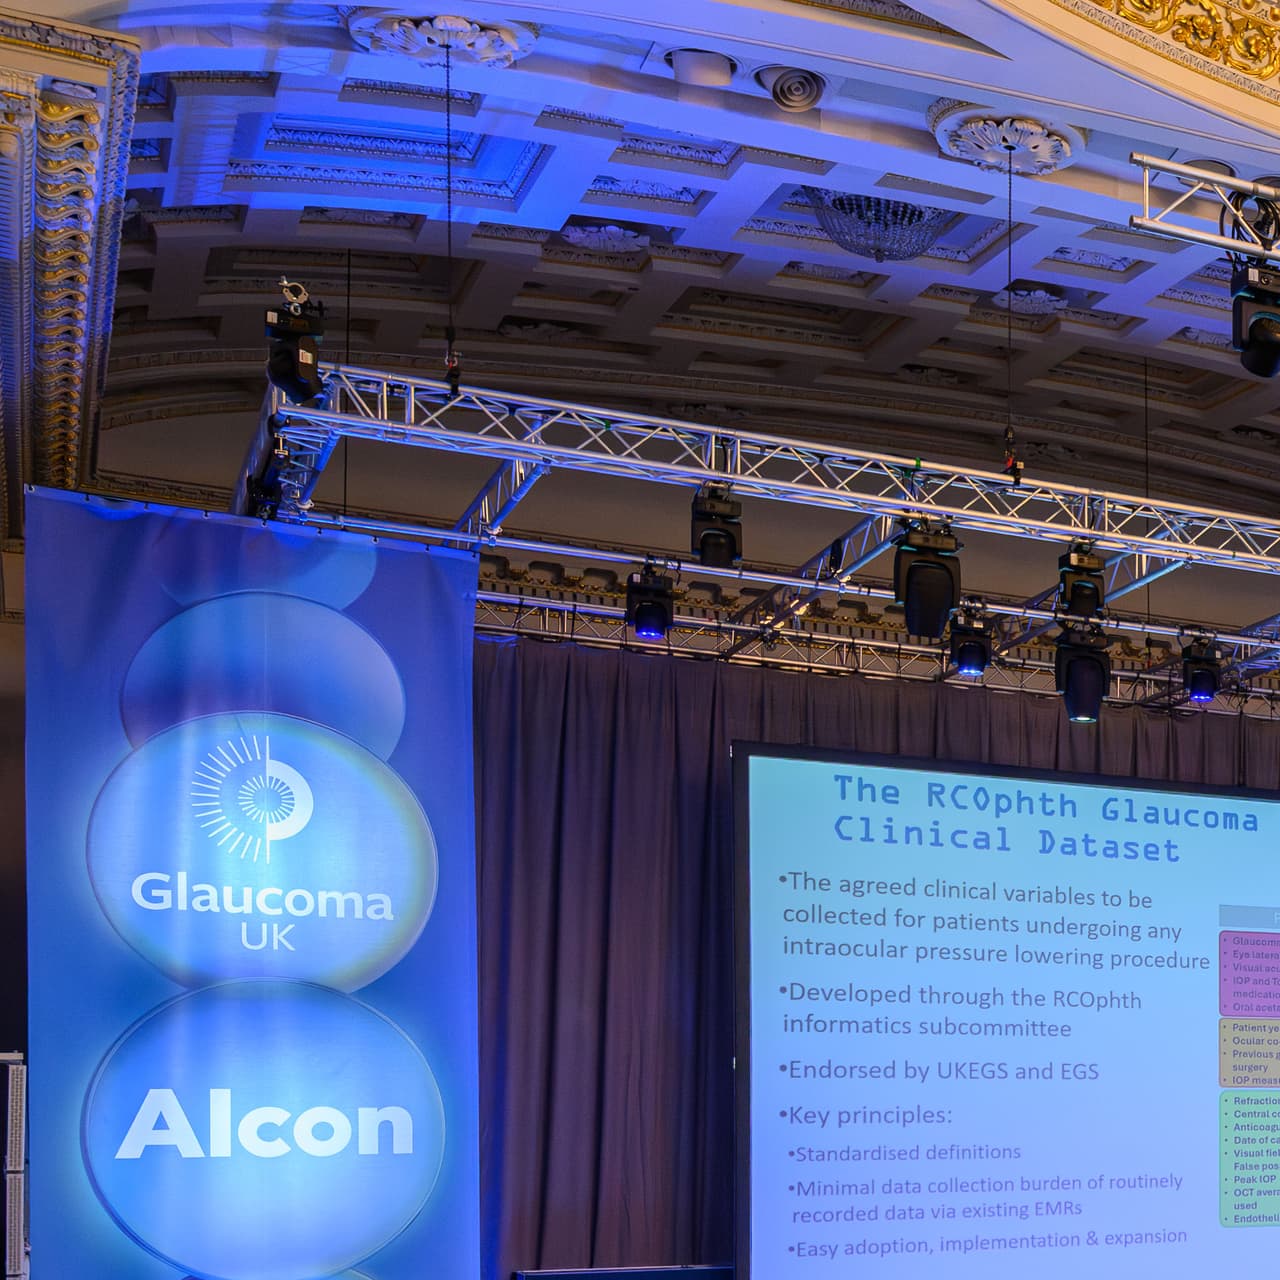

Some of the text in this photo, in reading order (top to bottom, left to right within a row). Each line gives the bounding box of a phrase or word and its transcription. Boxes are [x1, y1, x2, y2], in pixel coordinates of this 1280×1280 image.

[834, 774, 901, 805] The
[928, 782, 1078, 820] RCOphth
[1102, 798, 1259, 832] Glaucoma
[835, 816, 1181, 862] Clinical Dataset
[131, 872, 394, 921] Glaucoma
[788, 872, 1153, 909] The agreed clinical variables to be
[240, 923, 295, 951] UK
[783, 905, 1182, 943] collected for patients undergoing any
[783, 937, 1210, 973] intraocular pressure lowering procedure
[790, 983, 1142, 1012] Developed through the RCOphth
[783, 1014, 1072, 1038] informatics subcommittee
[790, 1060, 1099, 1084] Endorsed by UKEGS and EGS
[115, 1088, 413, 1159] Alcon
[790, 1104, 952, 1128] Key principles:
[797, 1143, 1021, 1163] Standardised definitions
[797, 1173, 1183, 1197] Minimal data collection burden of routinely
[792, 1201, 1083, 1224] recorded data via existing EMRs
[797, 1228, 1187, 1260] Easy adoption, implementation & expansion
